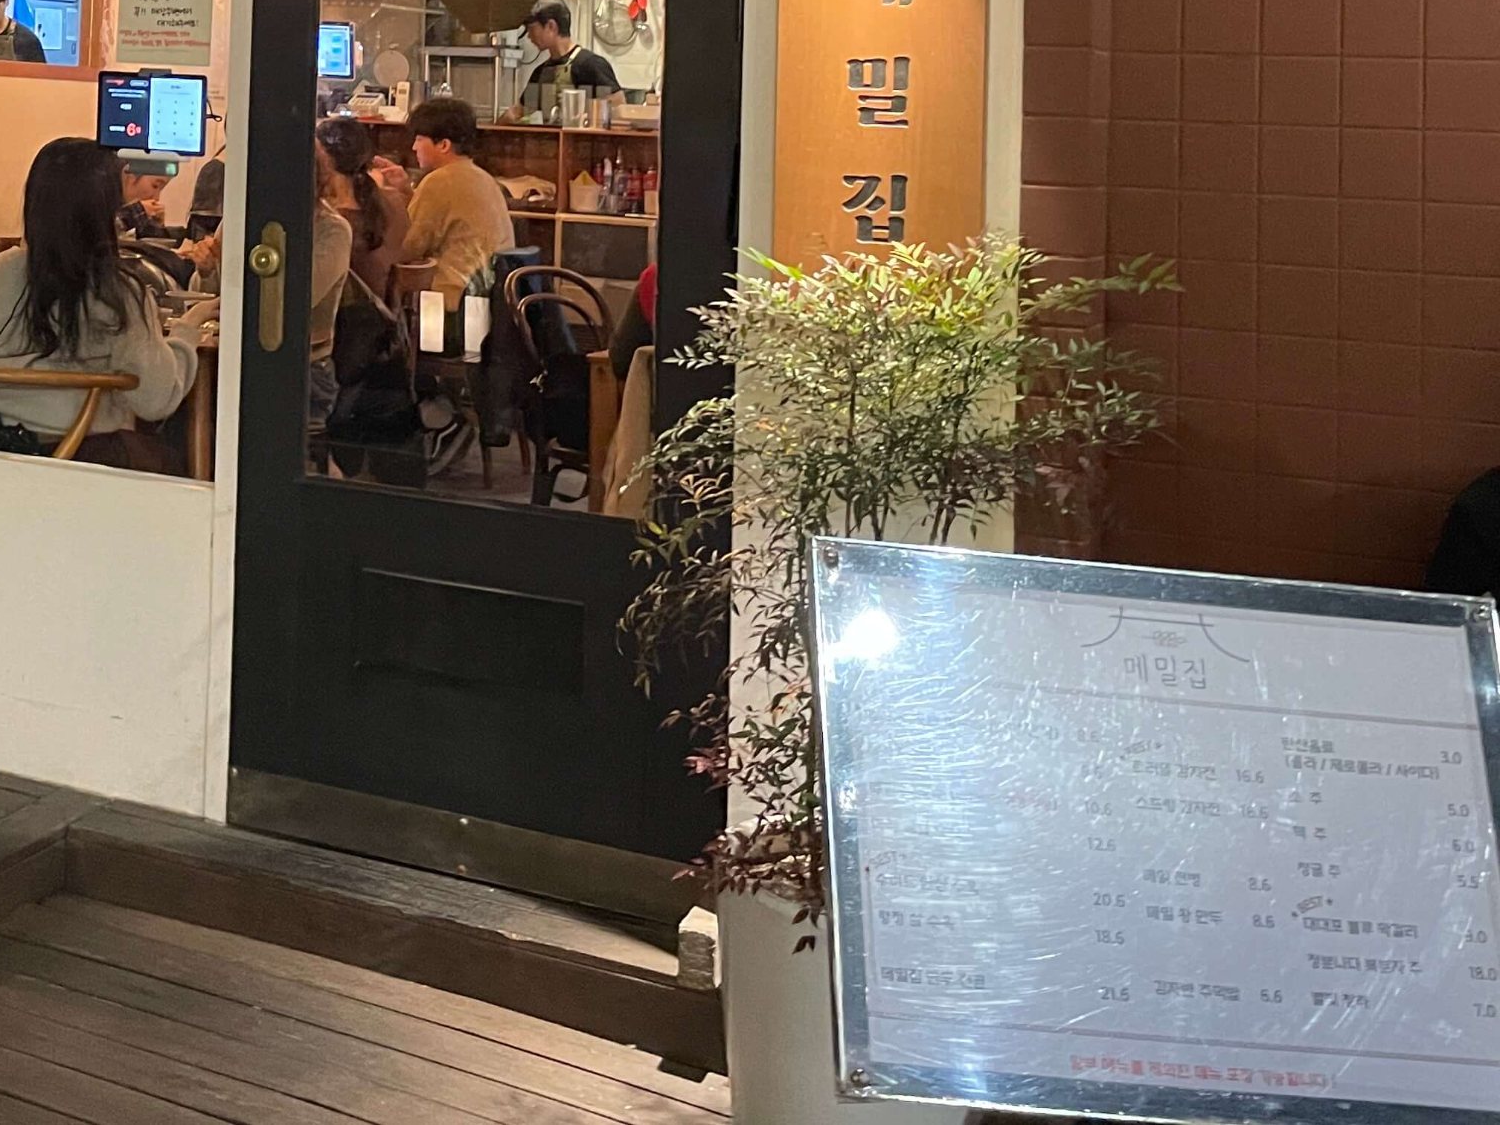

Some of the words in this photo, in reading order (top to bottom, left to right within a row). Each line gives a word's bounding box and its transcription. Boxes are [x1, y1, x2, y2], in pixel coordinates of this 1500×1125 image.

[1124, 653, 1207, 690] 메밀집
[1439, 751, 1462, 764] 3.0
[1473, 1003, 1496, 1018] 7.0
